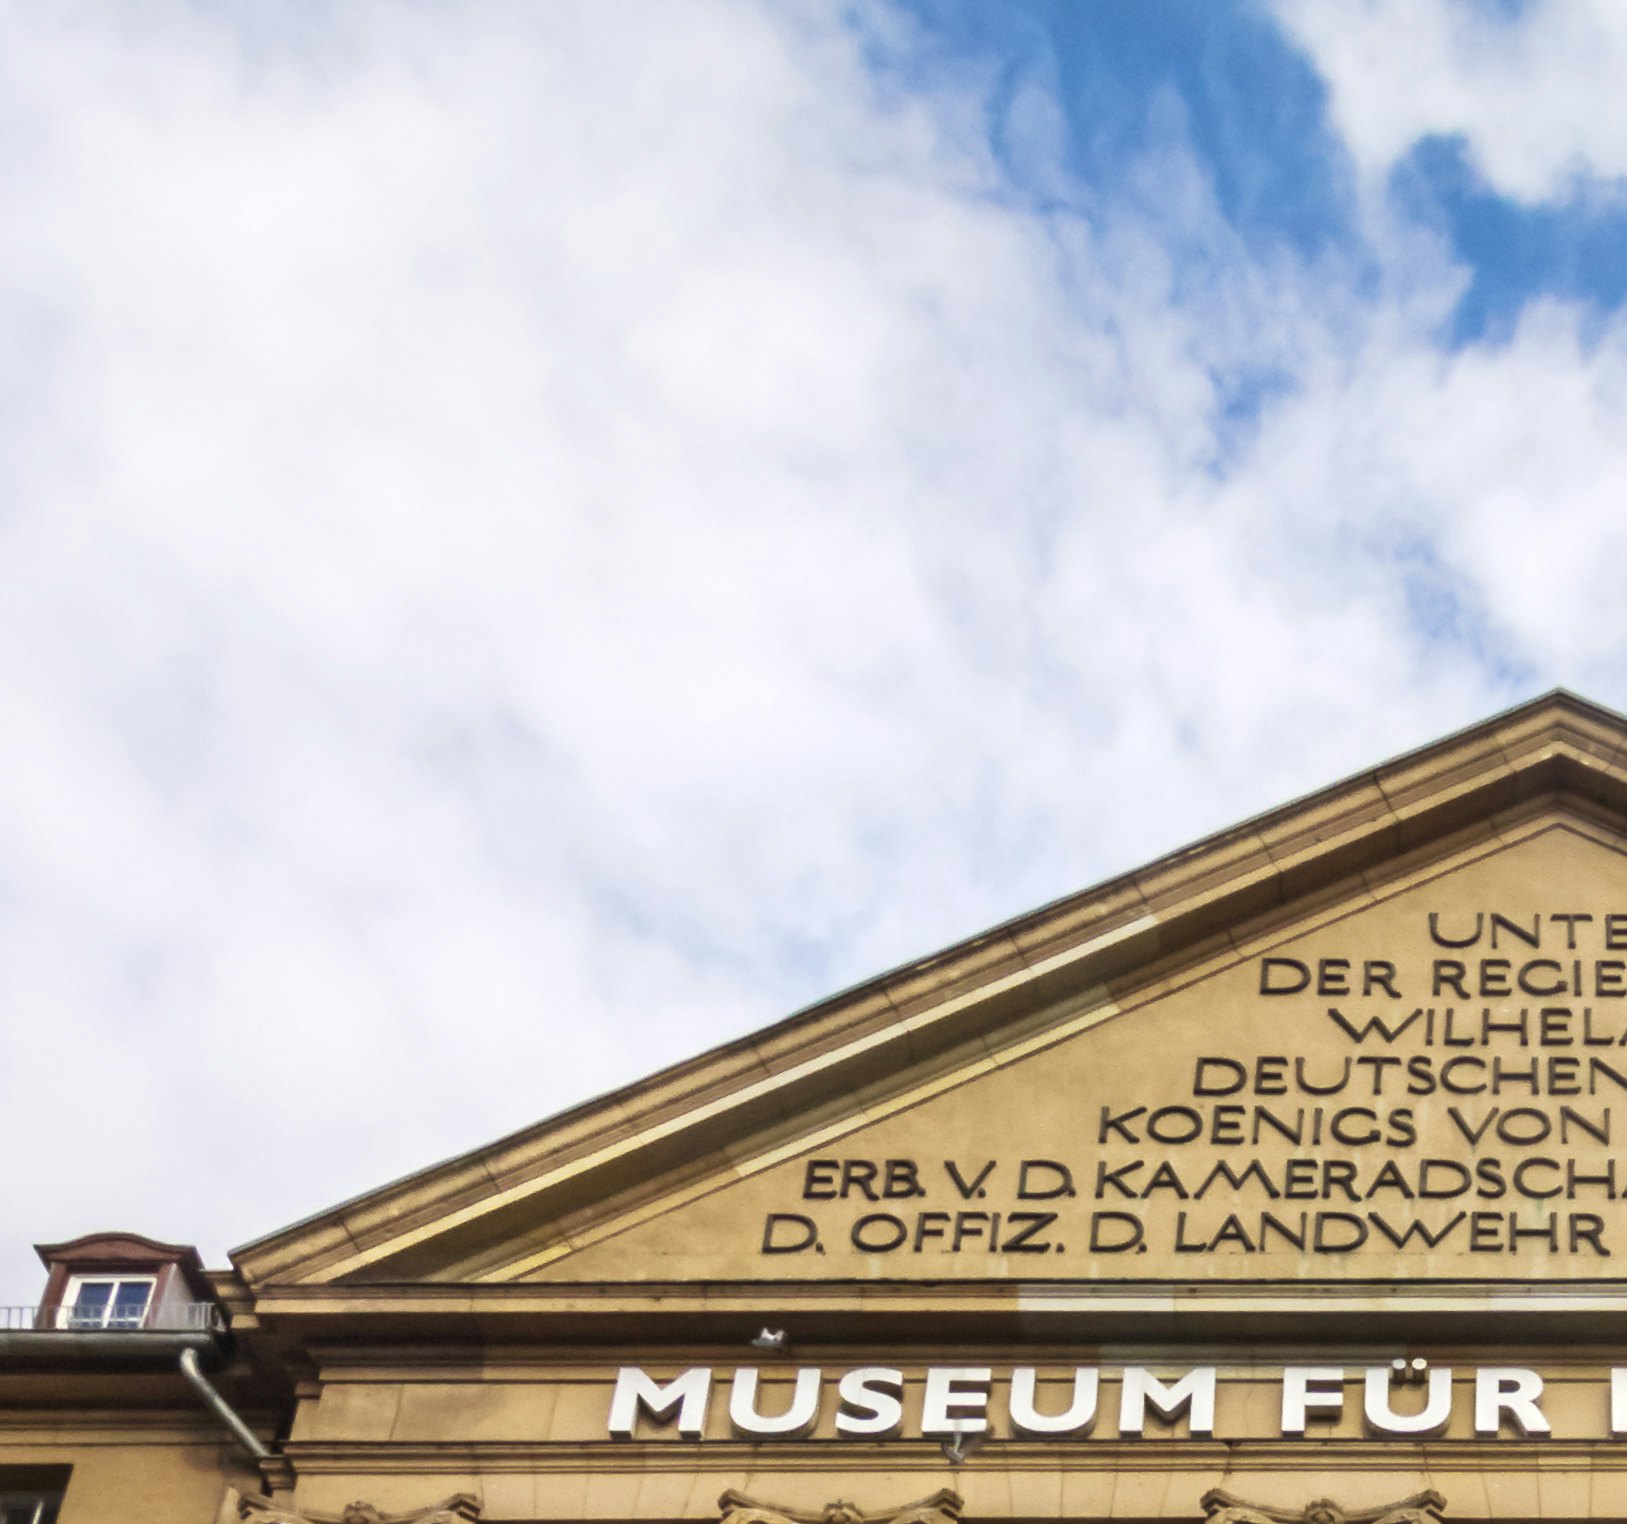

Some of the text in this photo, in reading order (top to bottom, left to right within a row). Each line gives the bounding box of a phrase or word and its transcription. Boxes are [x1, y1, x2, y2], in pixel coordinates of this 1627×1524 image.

[1260, 958, 1401, 998] DER
[1099, 1106, 1415, 1147] KOENIGS
[1448, 1107, 1609, 1146] VON
[803, 1160, 925, 1201] ERB.
[945, 1161, 996, 1199] V.
[1018, 1160, 1076, 1200] D.
[762, 1214, 823, 1254] D.
[851, 1212, 1064, 1253] OFFIZ.
[1090, 1212, 1146, 1254] D.
[1175, 1212, 1610, 1256] LANDWEHR
[608, 1367, 1217, 1439] MUSEUM
[1282, 1358, 1552, 1438] FÜR
